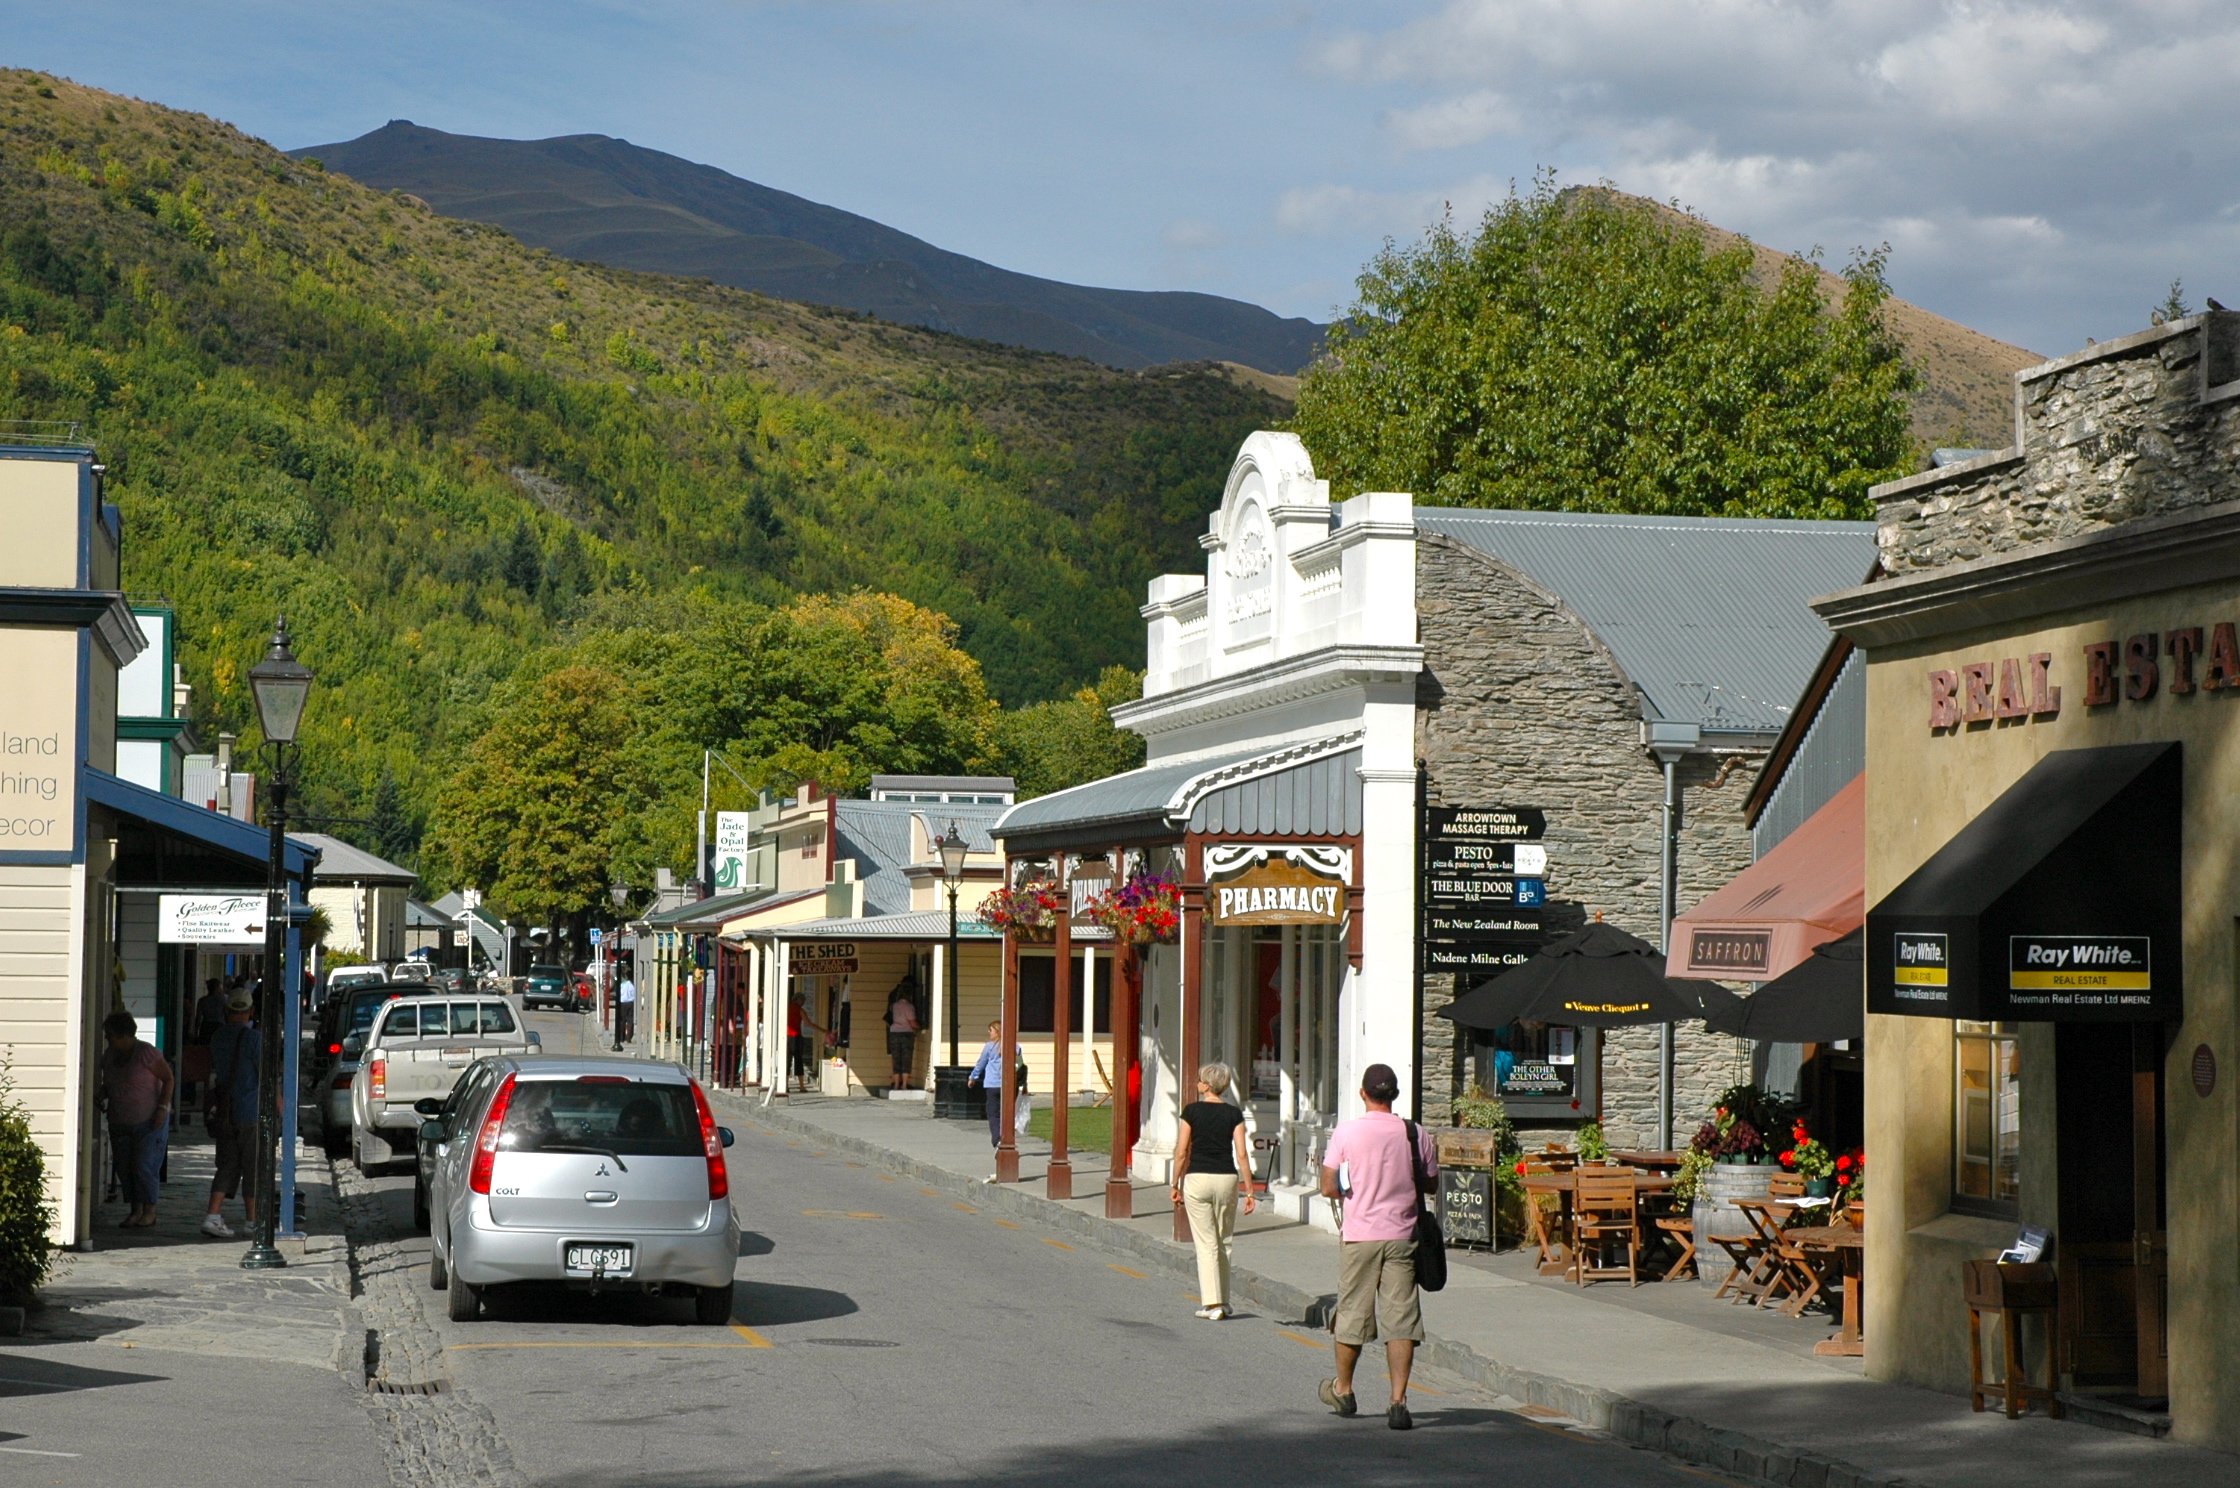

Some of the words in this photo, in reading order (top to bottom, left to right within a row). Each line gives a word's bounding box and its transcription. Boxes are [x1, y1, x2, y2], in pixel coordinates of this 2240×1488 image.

[1928, 652, 2061, 728] REAL
[2083, 622, 2240, 706] ESTA
[1455, 813, 1517, 824] ARROWTOWN
[719, 823, 744, 831] Jade
[1442, 824, 1488, 834] MASSAGE
[1489, 825, 1529, 835] THERAPY
[720, 837, 744, 846] Opal
[1455, 846, 1493, 860] PESTO
[1431, 880, 1452, 892] THE
[1454, 881, 1481, 893] BLUE
[1482, 882, 1513, 894] DOOR
[1219, 886, 1338, 919] PHARMACY
[1464, 893, 1480, 902] BAR
[176, 901, 218, 919] Golden
[219, 898, 261, 916] Fleece
[1432, 918, 1450, 929] The
[1452, 919, 1473, 929] New
[1474, 920, 1511, 930] Zealand
[1513, 920, 1539, 930] Room
[818, 944, 855, 958] SHED
[1697, 942, 1763, 961] SAFFRON
[1901, 941, 1917, 964] Ray
[1917, 942, 1941, 962] White
[2027, 945, 2070, 968] Ray
[2072, 945, 2132, 965] White
[1432, 952, 1468, 963] Nadene
[1471, 953, 1500, 964] Milne
[802, 965, 852, 974] TAKEAWAYS
[2053, 975, 2076, 985] REAL
[2078, 976, 2108, 985] ESTATE
[2010, 993, 2050, 1004] Newman
[2052, 993, 2072, 1004] Real
[2074, 994, 2102, 1004] Estate
[2104, 994, 2118, 1004] Ltd
[2120, 996, 2151, 1005] MREINZ
[1572, 1001, 1600, 1012] Veuve
[1602, 1003, 1640, 1014] Clicquot
[1512, 1065, 1528, 1073] THE
[1529, 1065, 1556, 1073] OTHER
[1509, 1072, 1539, 1081] BOLEYN
[1541, 1072, 1559, 1081] GIRL
[495, 1187, 520, 1196] COLT
[1446, 1191, 1482, 1205] PESTO
